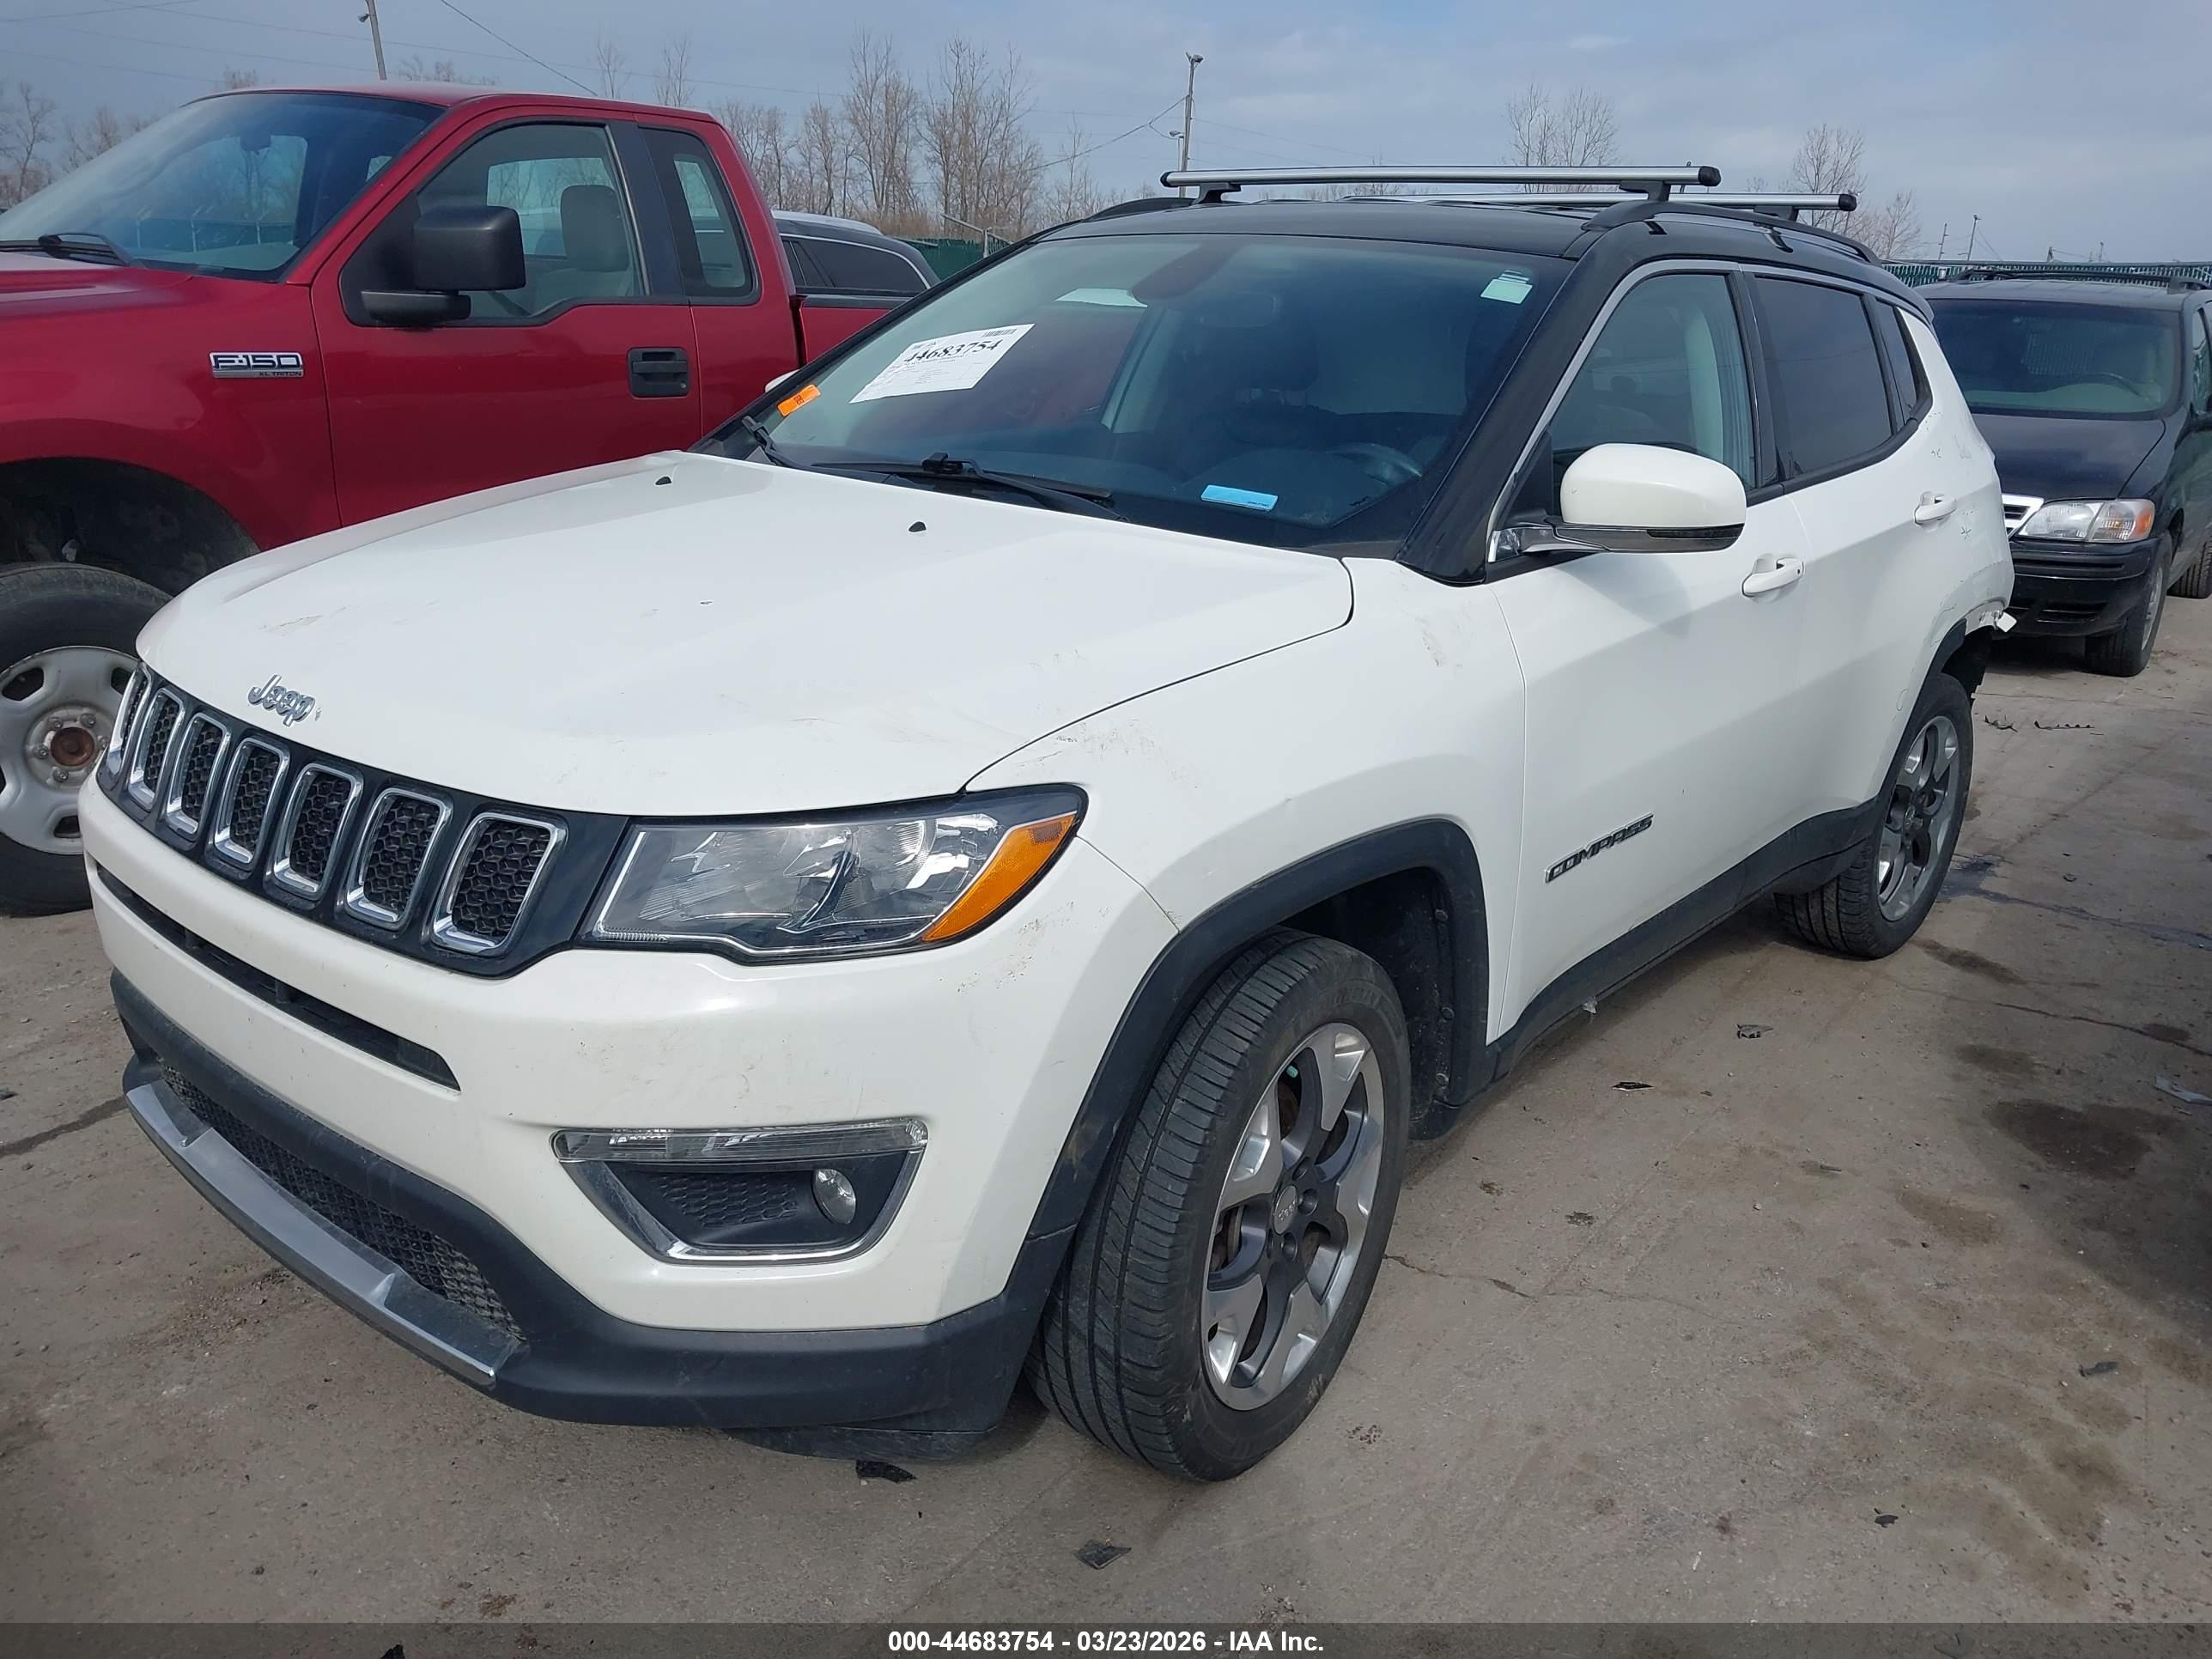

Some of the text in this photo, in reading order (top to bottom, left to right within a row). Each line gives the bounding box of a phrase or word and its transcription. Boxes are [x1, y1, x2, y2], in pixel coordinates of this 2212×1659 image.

[212, 354, 301, 369] F-150
[903, 338, 1004, 362] 44683754
[248, 674, 315, 727] Jeep
[1545, 813, 1654, 883] COMPASS
